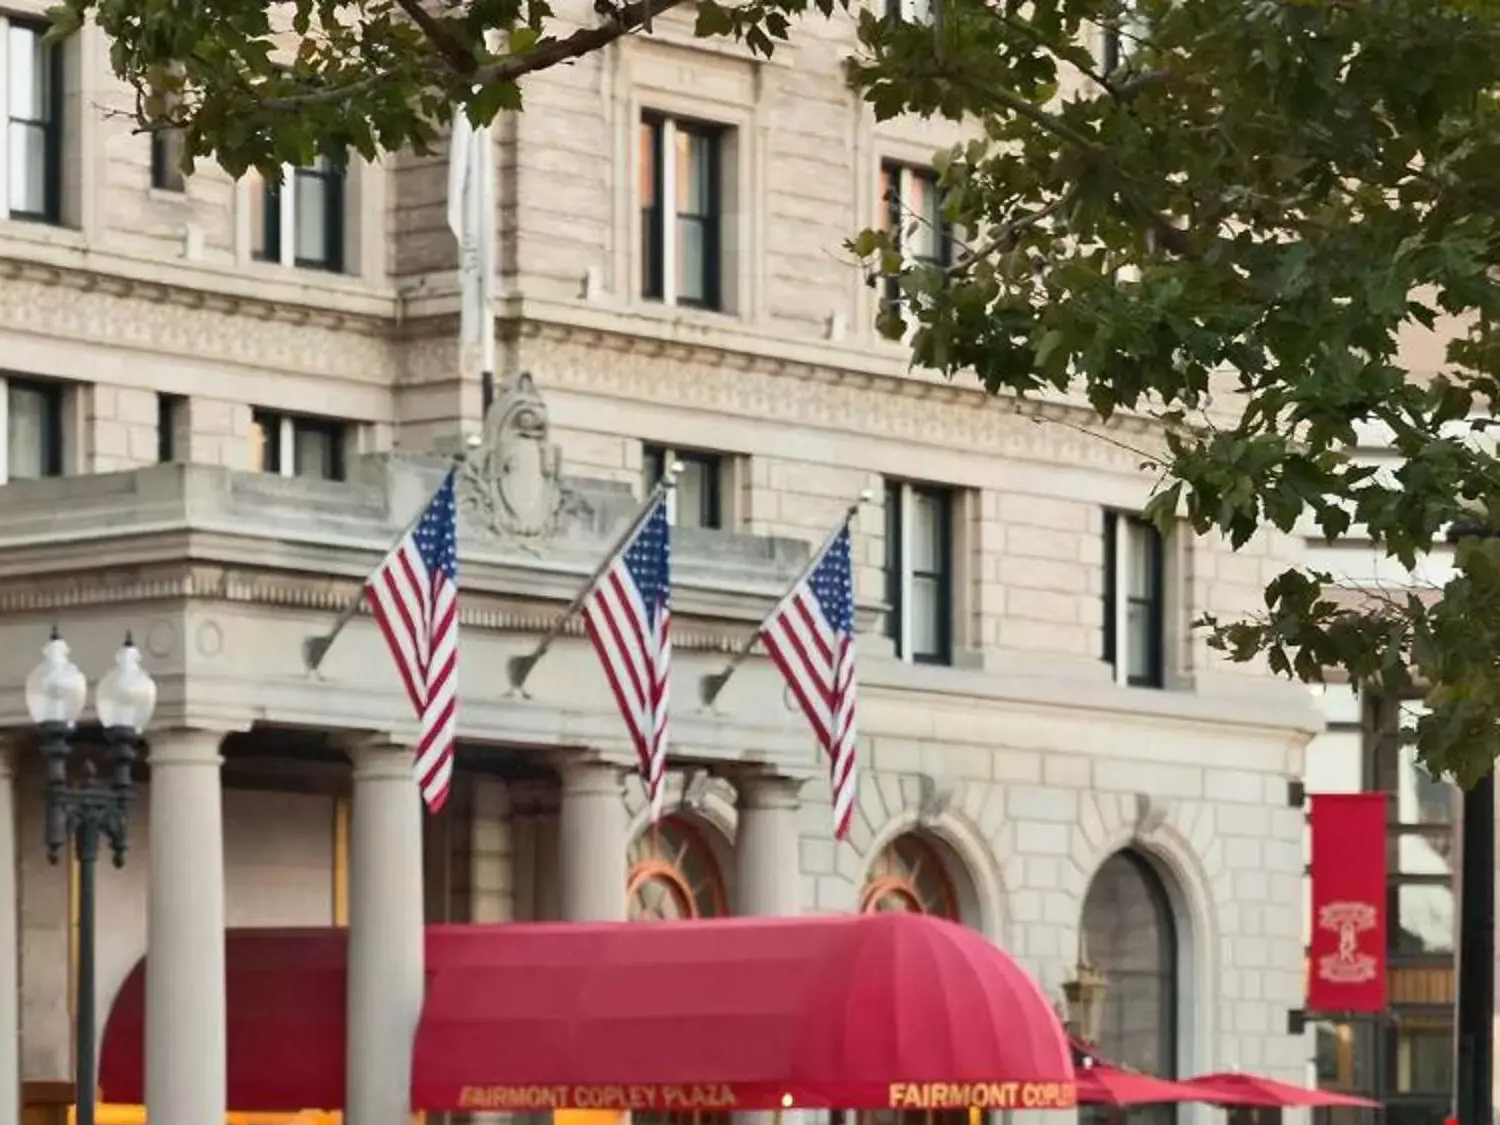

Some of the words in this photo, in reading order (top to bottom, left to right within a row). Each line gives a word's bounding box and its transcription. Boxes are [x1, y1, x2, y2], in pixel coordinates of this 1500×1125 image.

[457, 1084, 569, 1107] FAIRMONT
[573, 1084, 657, 1107] COPLEY
[661, 1084, 738, 1106] PLAZA
[888, 1082, 1020, 1108] FAIRMONT
